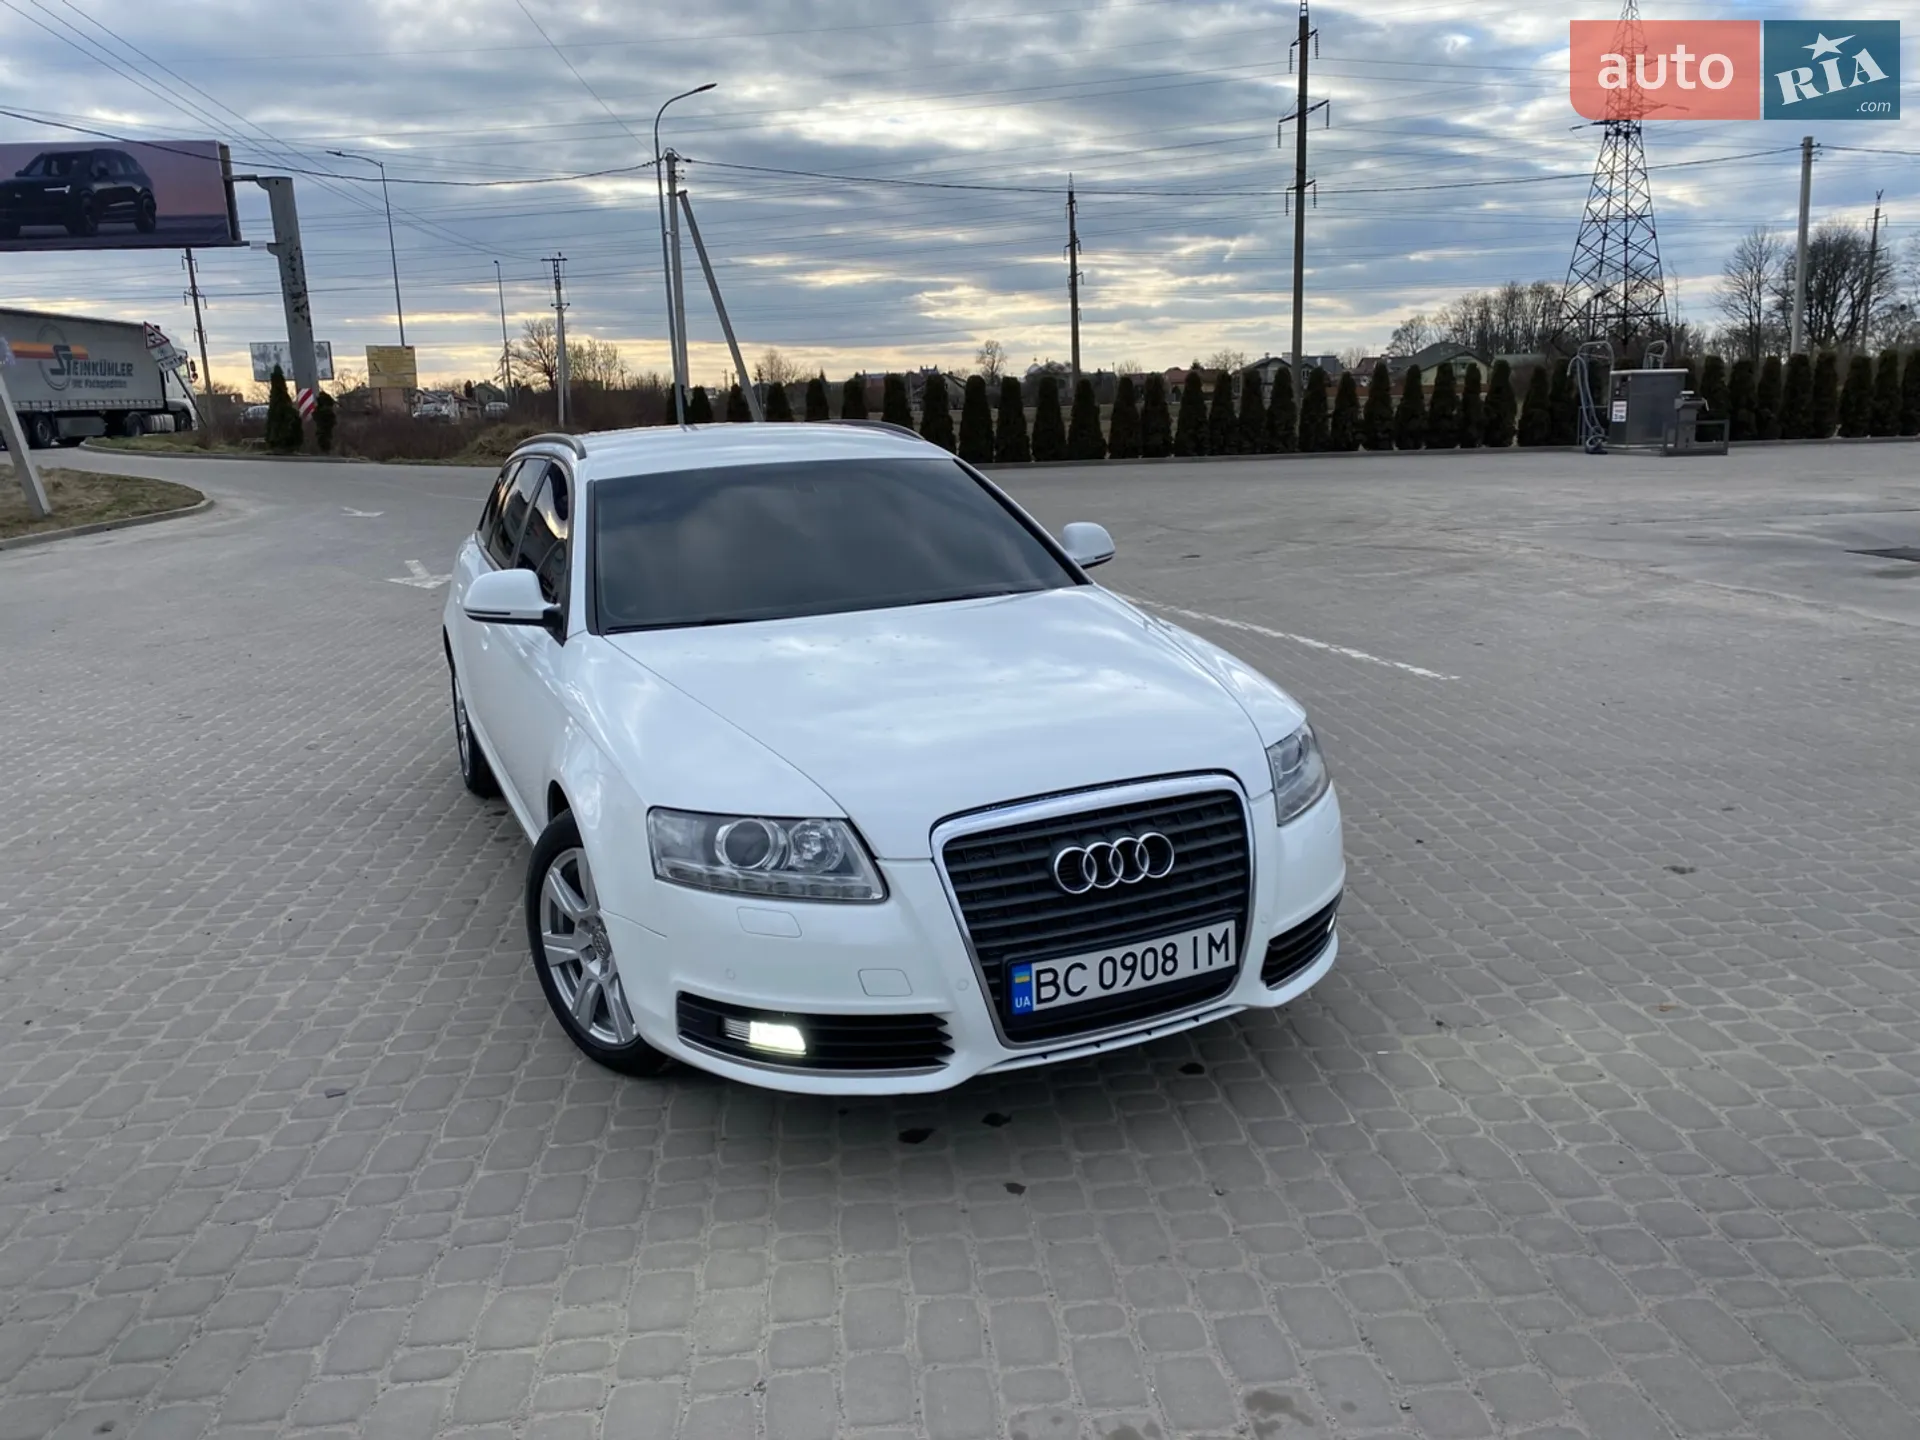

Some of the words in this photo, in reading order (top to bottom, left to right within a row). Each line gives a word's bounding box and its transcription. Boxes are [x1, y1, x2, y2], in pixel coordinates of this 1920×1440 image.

[1036, 963, 1087, 1004] BC
[1099, 942, 1178, 990] 0908
[1015, 996, 1031, 1008] UA
